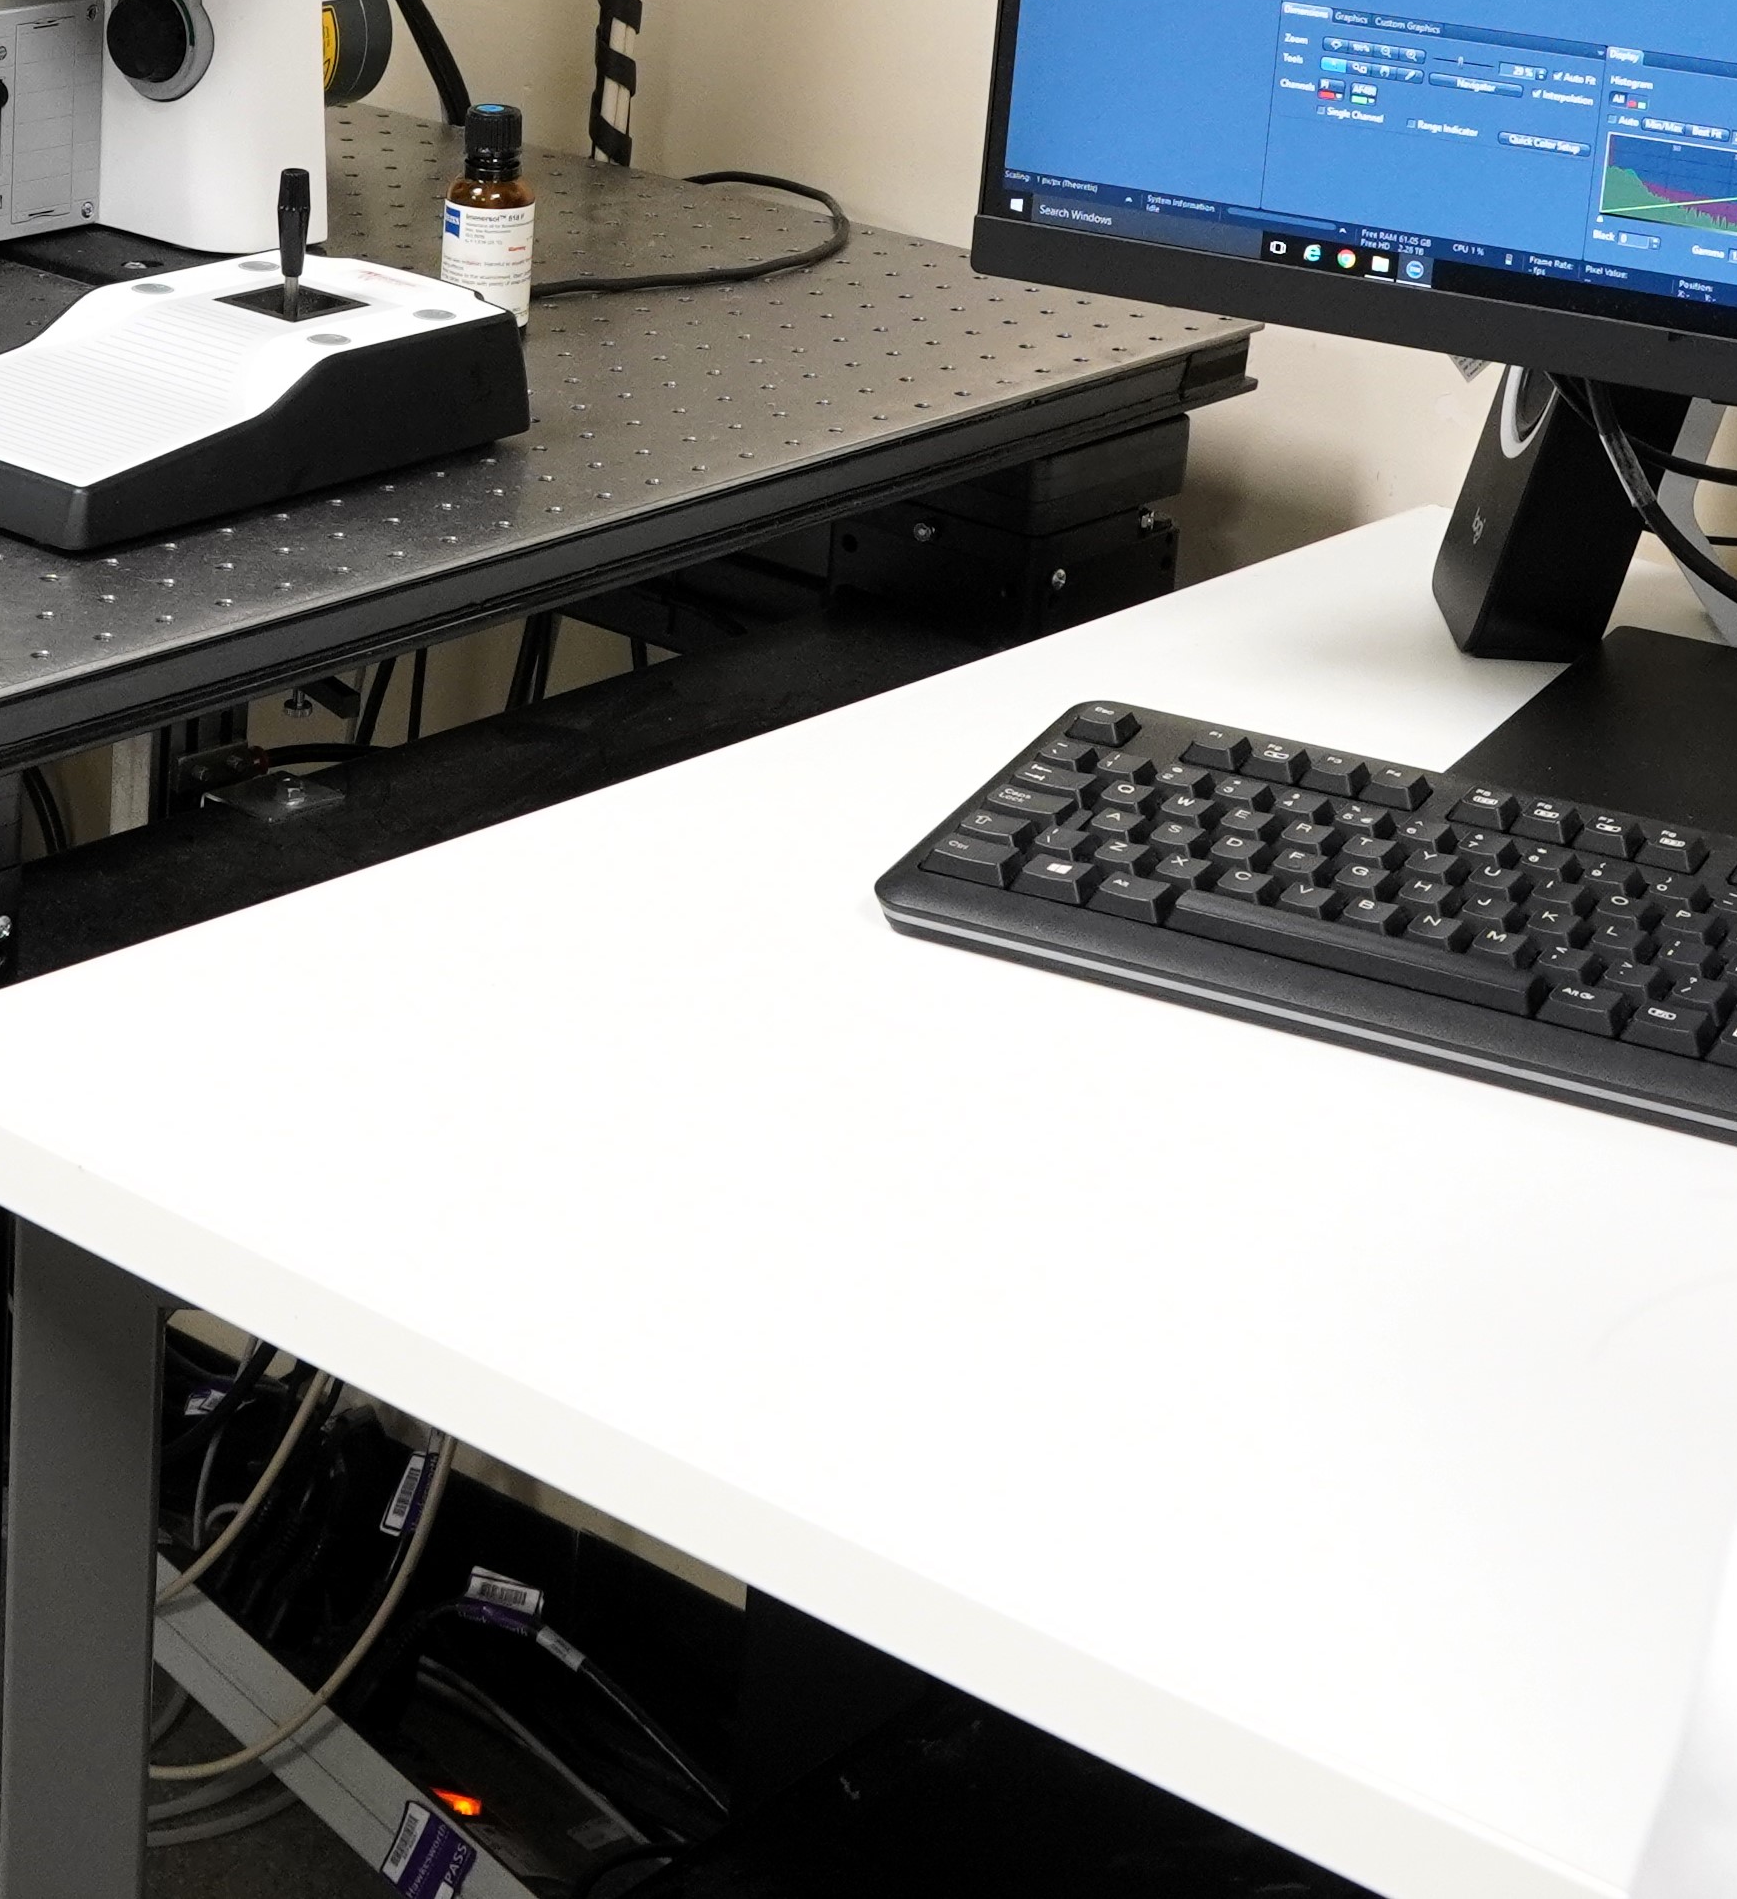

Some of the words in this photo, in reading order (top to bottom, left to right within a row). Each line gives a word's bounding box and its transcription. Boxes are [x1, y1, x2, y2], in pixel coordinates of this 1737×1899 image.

[1284, 6, 1329, 19] Dimensions
[1335, 12, 1368, 25] Graphics
[1375, 17, 1405, 30] Custom
[1407, 21, 1441, 35] Graphics
[1284, 33, 1309, 45] Zoom
[1282, 53, 1304, 65] Tools
[1456, 79, 1496, 92] Navigator
[1610, 75, 1654, 90] Histogram
[1543, 90, 1594, 106] Interpolation
[1327, 107, 1351, 119] Single
[1351, 110, 1384, 123] Channel
[1417, 120, 1442, 133] Range
[1443, 124, 1478, 137] Indicator
[1509, 135, 1533, 147] Quick
[1534, 138, 1556, 150] Color
[1556, 141, 1581, 155] Setup
[1147, 194, 1171, 206] System
[1171, 199, 1215, 213] Information
[1039, 204, 1070, 219] Search
[1071, 209, 1112, 225] Windows
[1362, 228, 1378, 239] Free
[1379, 232, 1397, 243] RAM
[1420, 237, 1432, 247] GB
[1452, 243, 1469, 254] CPU
[1117, 784, 1135, 794] Q
[1177, 796, 1195, 806] W
[1106, 812, 1121, 821] A
[1234, 809, 1252, 819] E
[1167, 824, 1183, 833] S
[1296, 822, 1312, 833] R
[1109, 841, 1128, 852] Z
[1226, 837, 1244, 847] D
[1359, 836, 1373, 846] T
[1170, 855, 1189, 867] X
[1288, 851, 1305, 861] F
[1422, 851, 1437, 861] Y
[1235, 871, 1253, 881] C
[1352, 865, 1369, 877] G
[1484, 866, 1502, 877] U
[1299, 884, 1314, 894] V
[1414, 880, 1432, 892] H
[1358, 899, 1376, 910] B
[1611, 895, 1629, 906] O
[1422, 914, 1442, 927] N
[1541, 911, 1559, 922] K
[1675, 909, 1692, 921] P
[1486, 931, 1508, 943] M
[1606, 925, 1618, 937] L
[406, 1824, 448, 1899] Hawkesworth
[444, 1843, 467, 1884] PASS
